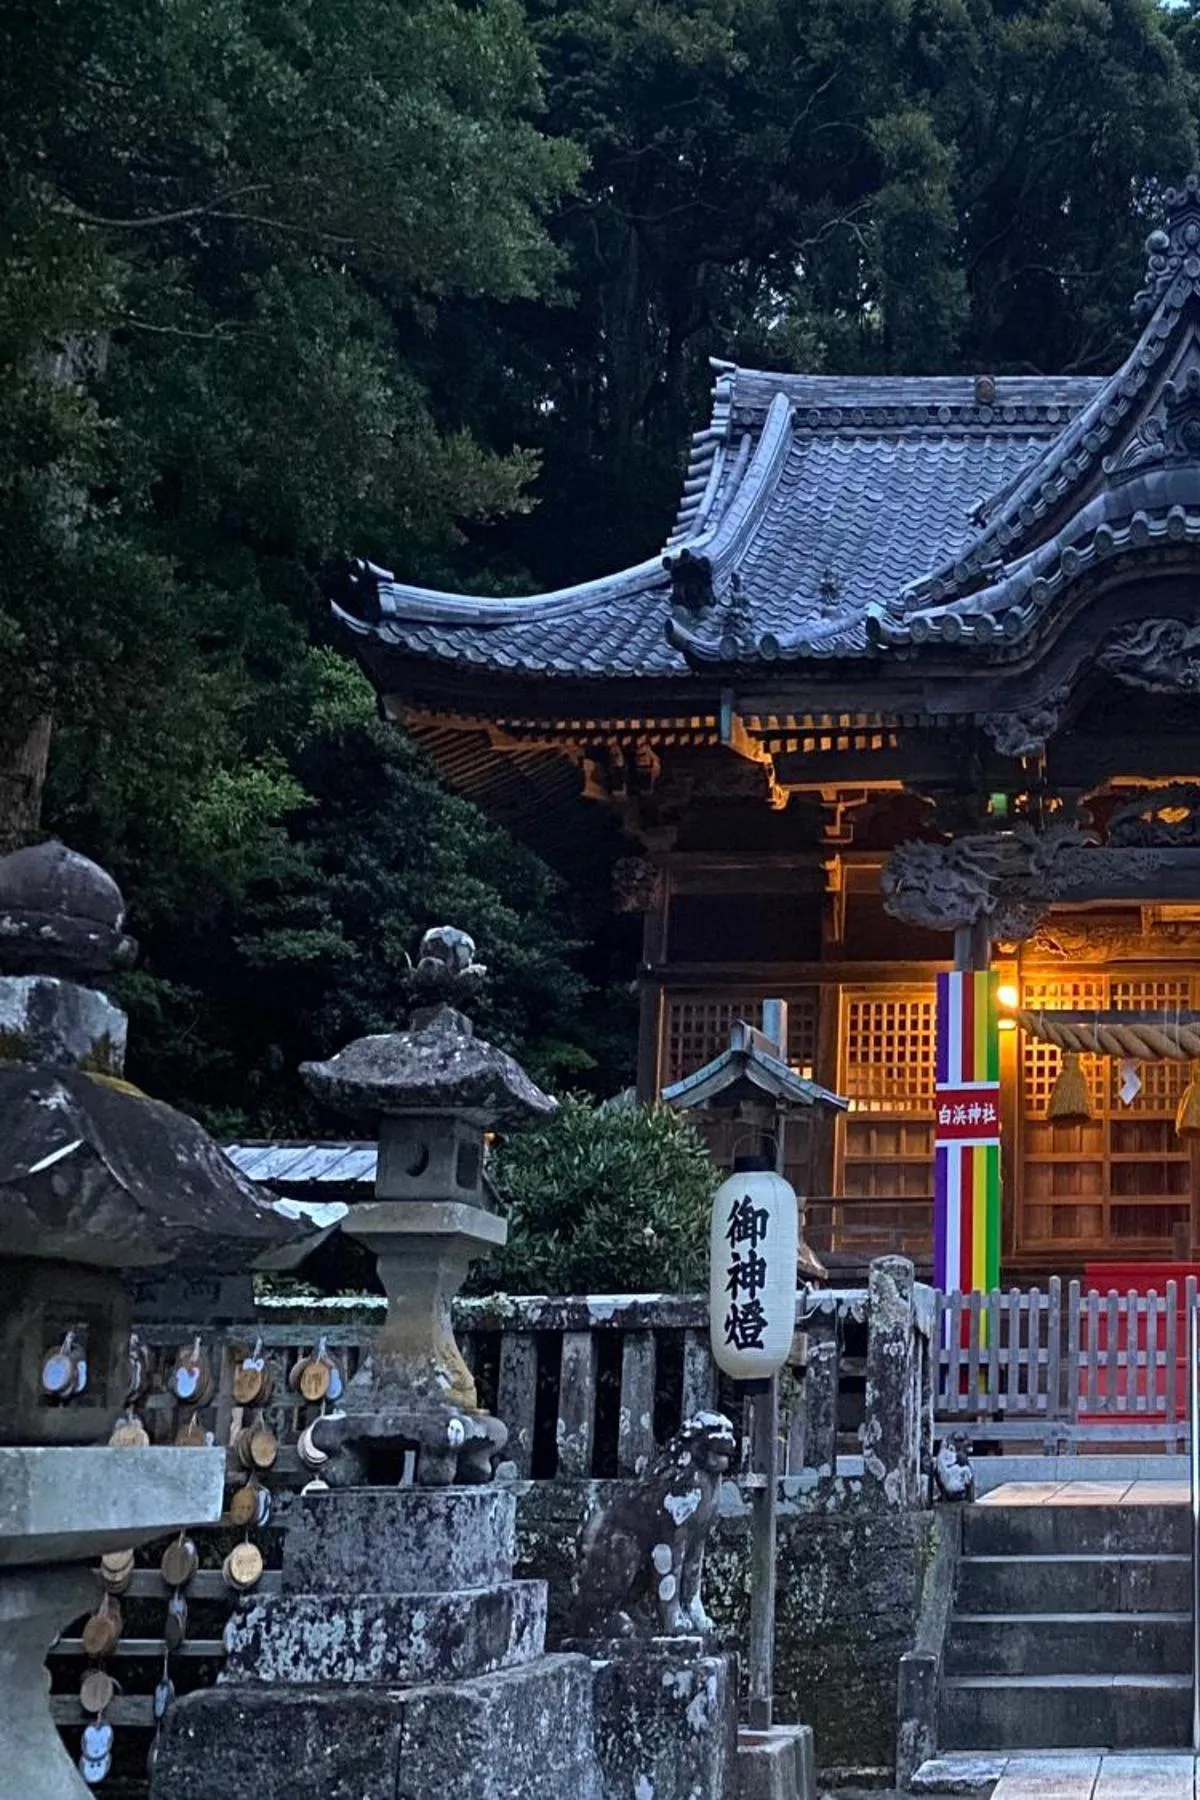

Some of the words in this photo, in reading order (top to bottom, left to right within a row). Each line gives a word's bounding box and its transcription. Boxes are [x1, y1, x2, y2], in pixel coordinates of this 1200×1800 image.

[938, 1102, 996, 1126] 白浜神社
[725, 1194, 769, 1351] 御神燈
